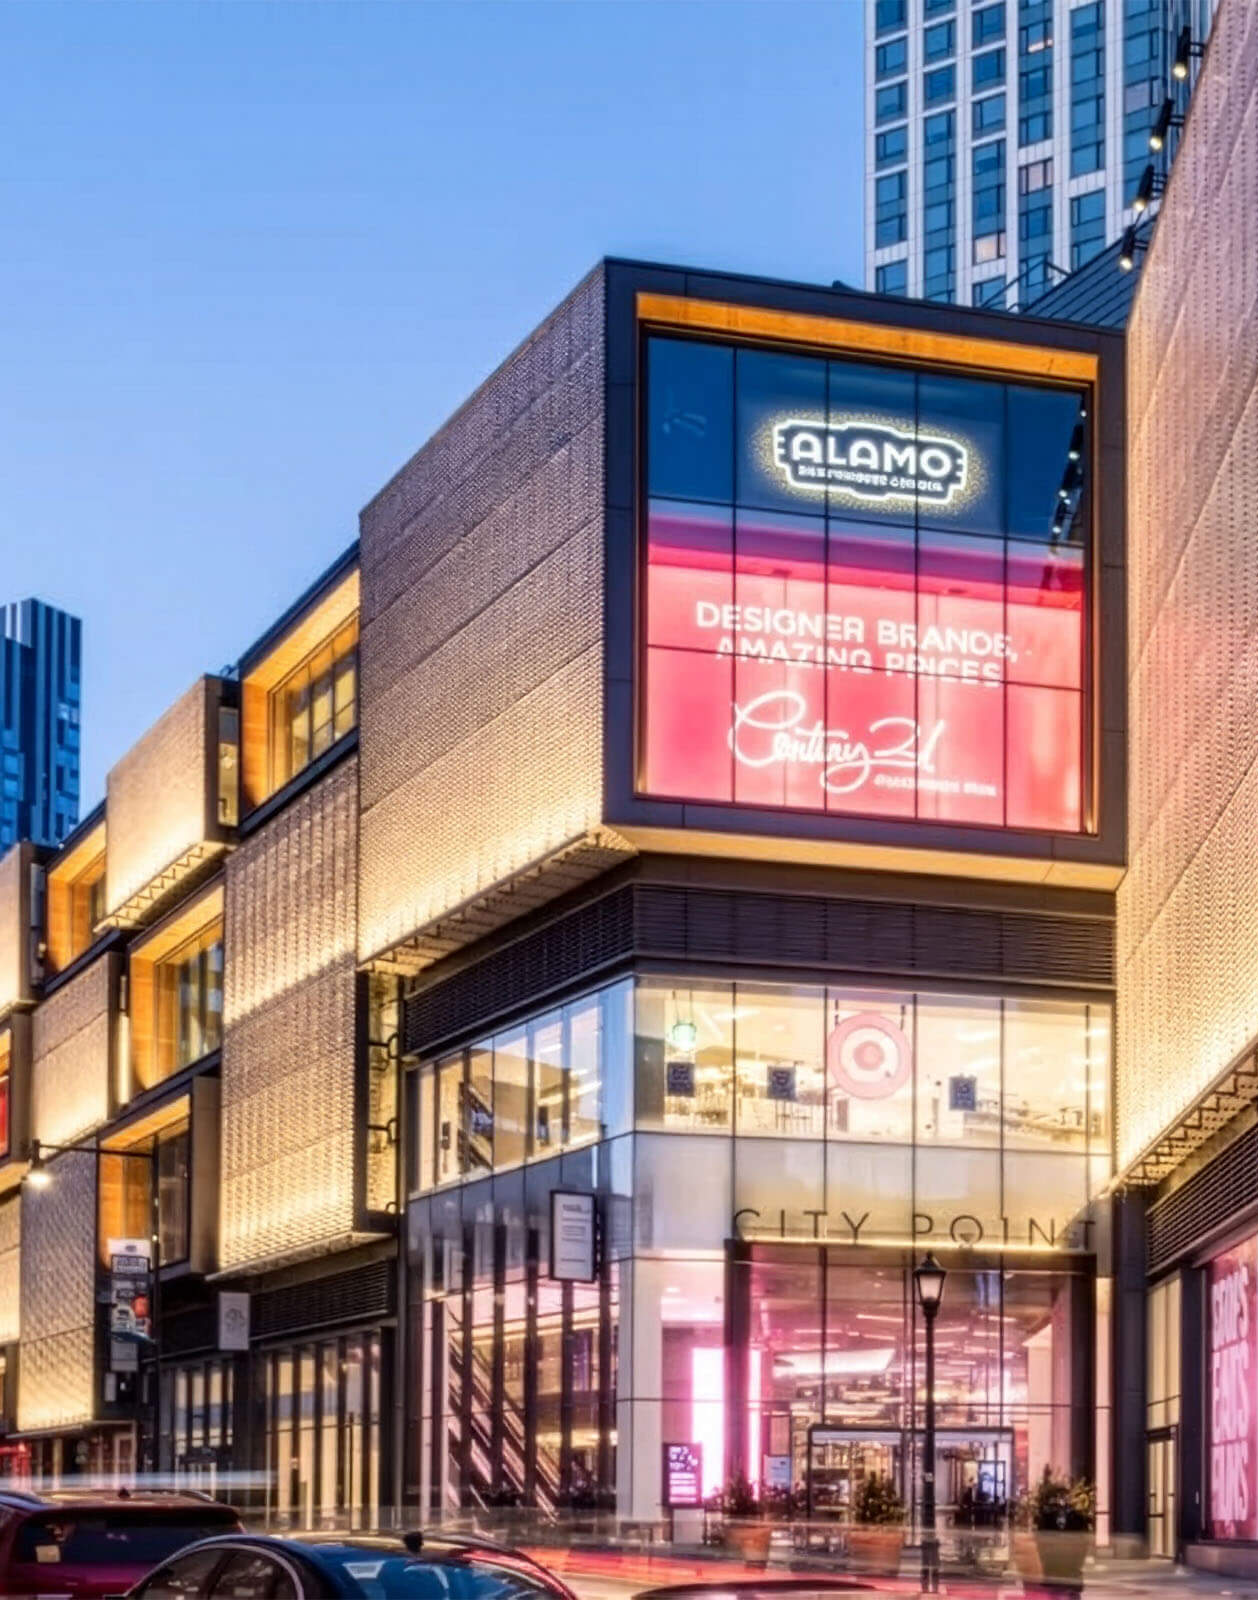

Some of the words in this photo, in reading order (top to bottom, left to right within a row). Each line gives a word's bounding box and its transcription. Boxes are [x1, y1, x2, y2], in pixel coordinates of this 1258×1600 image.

[792, 433, 952, 478] ALAMO
[696, 601, 866, 644] DESIGNER
[728, 690, 872, 794] Century
[733, 1208, 871, 1246] CITY
[912, 1212, 1097, 1253] POINT
